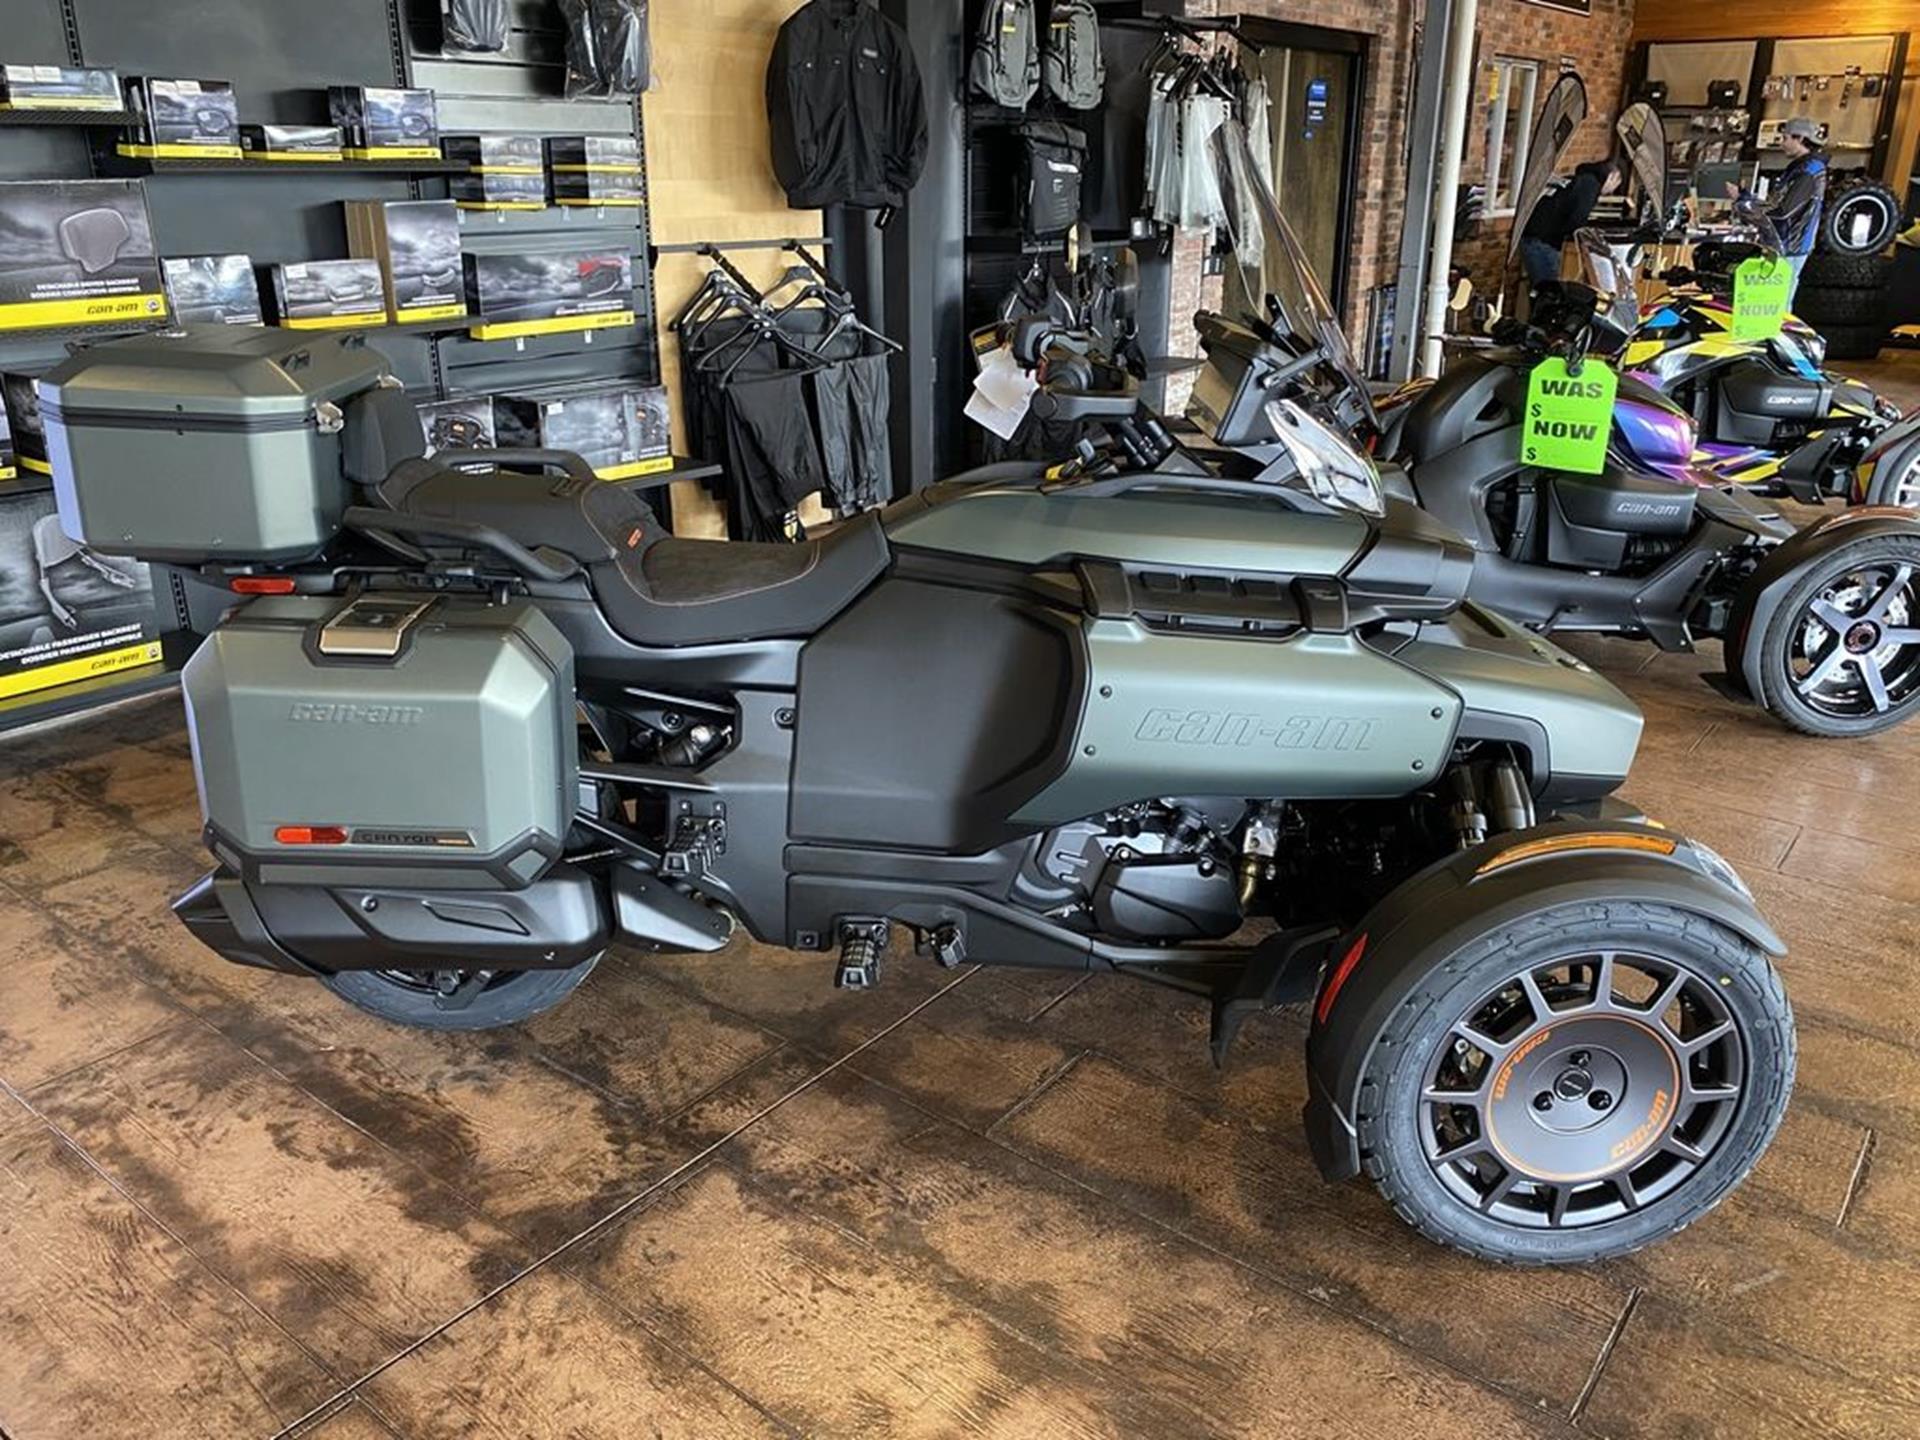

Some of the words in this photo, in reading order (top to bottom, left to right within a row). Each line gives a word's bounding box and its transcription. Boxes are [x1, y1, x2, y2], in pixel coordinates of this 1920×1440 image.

[1744, 274, 1783, 286] WAS
[1740, 305, 1778, 316] NOW
[1541, 380, 1603, 399] WAS
[1531, 403, 1542, 418] $
[1533, 420, 1598, 441] NOW
[1526, 447, 1537, 461] $
[1616, 502, 1681, 516] can-am
[289, 702, 423, 724] can-am
[1133, 707, 1381, 751] can-am
